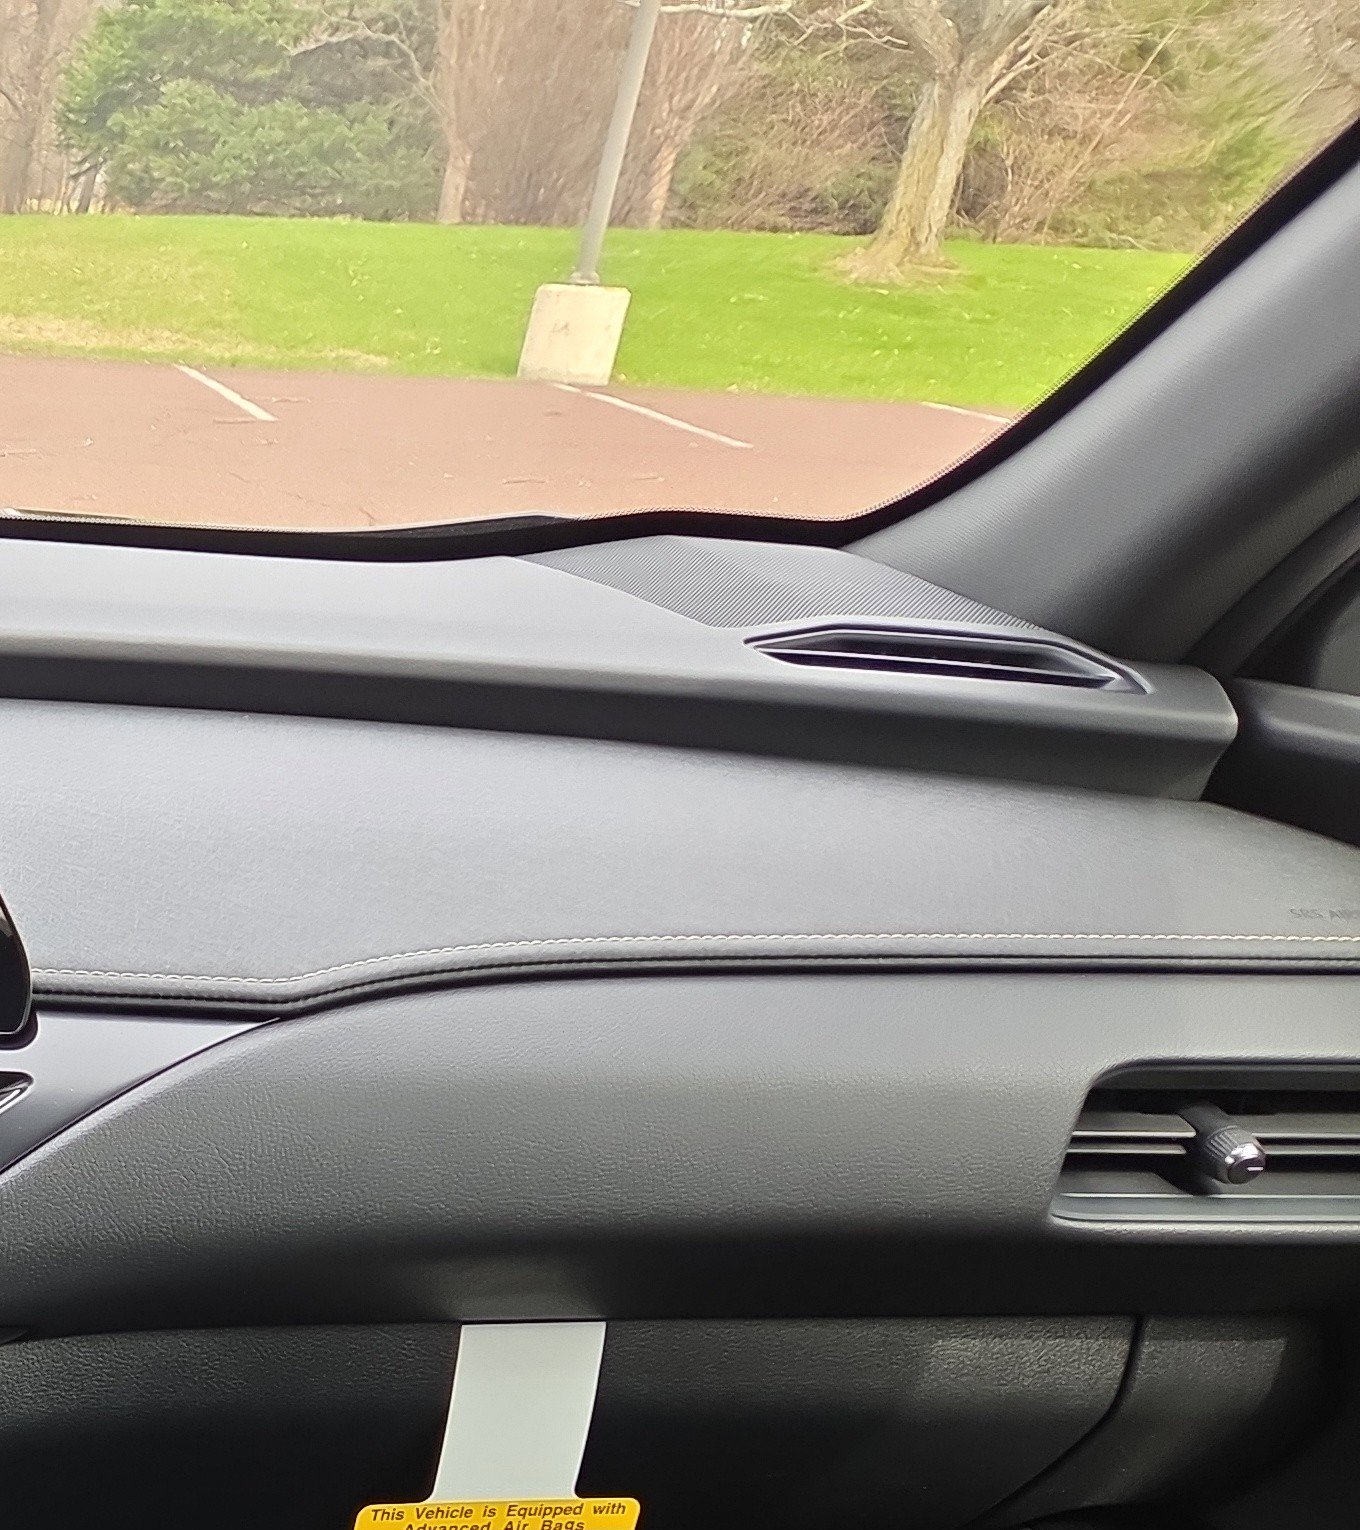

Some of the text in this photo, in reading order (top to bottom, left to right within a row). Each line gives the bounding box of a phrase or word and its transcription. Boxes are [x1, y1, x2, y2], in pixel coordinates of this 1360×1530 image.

[371, 1502, 626, 1521] This Vehicle is Equipped with
